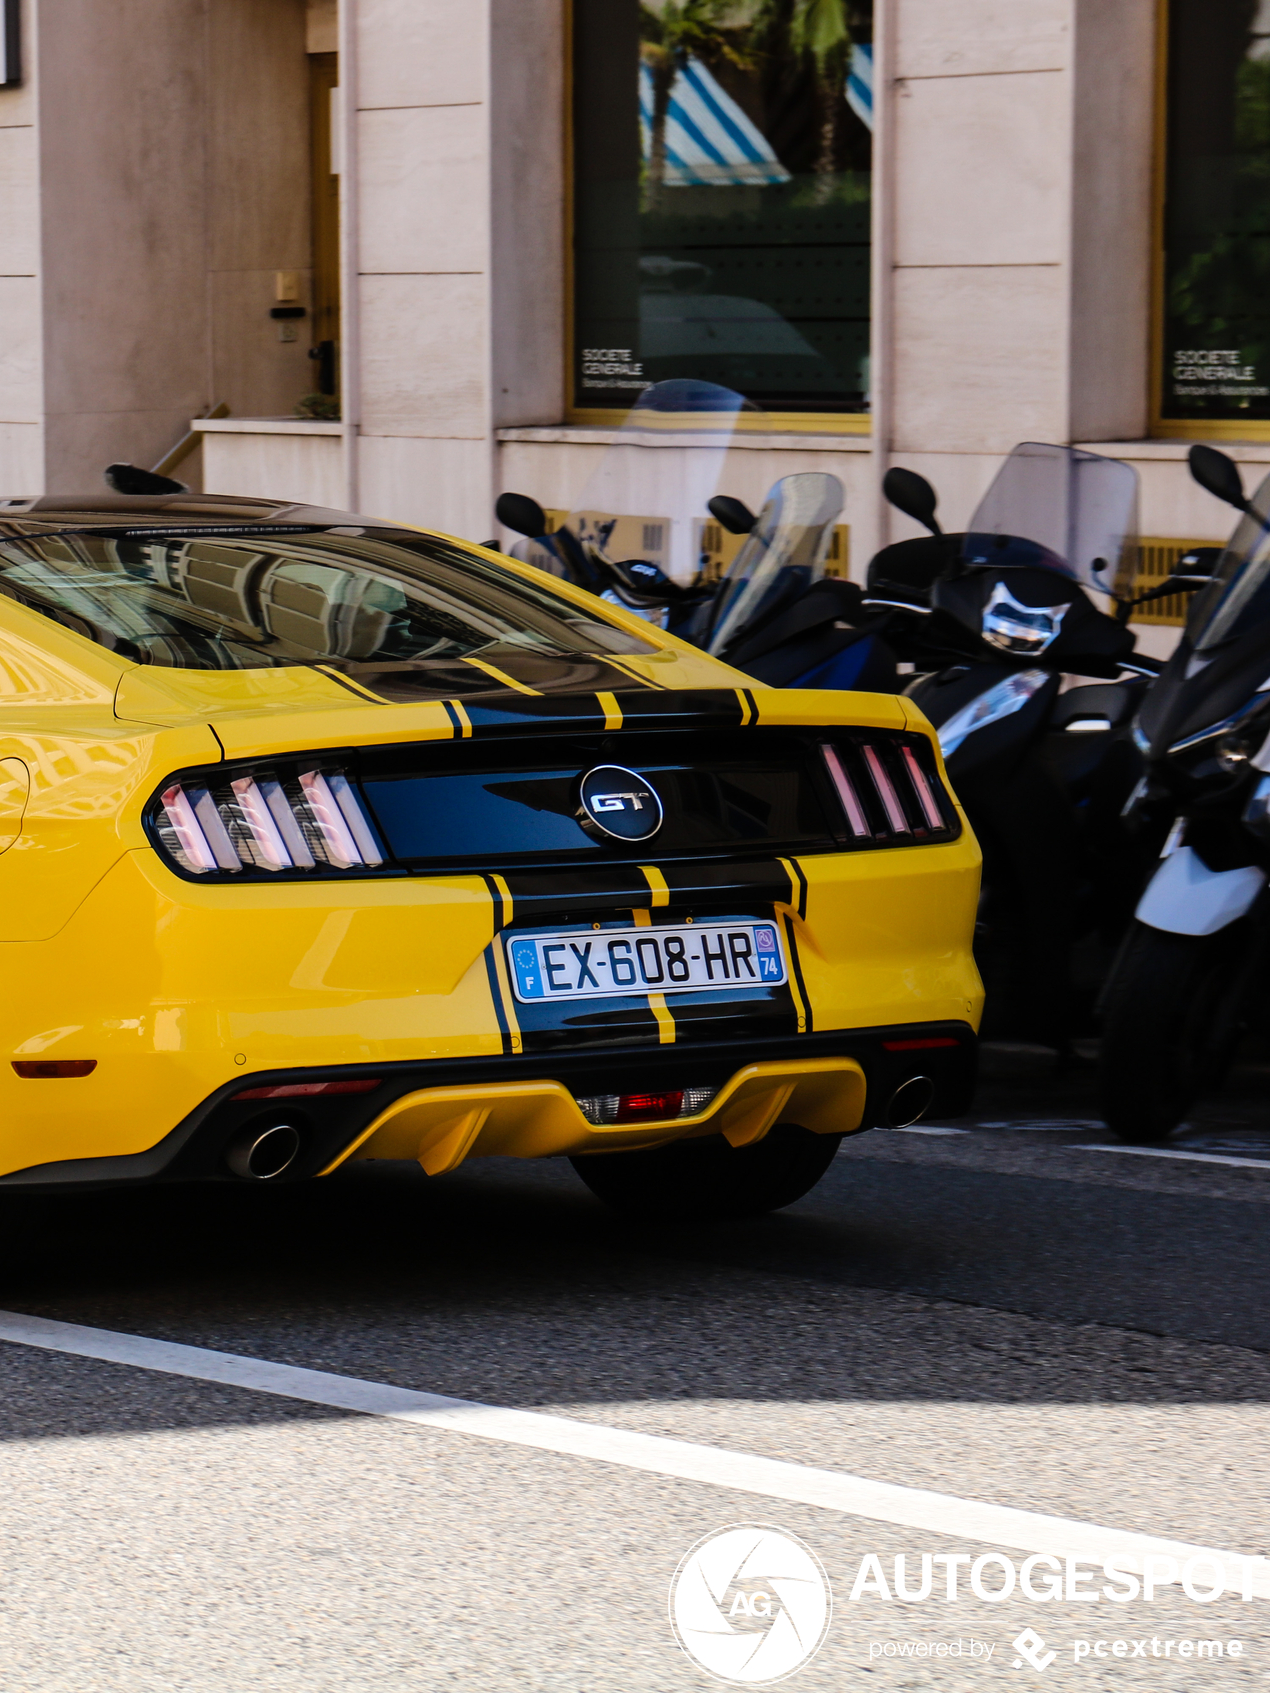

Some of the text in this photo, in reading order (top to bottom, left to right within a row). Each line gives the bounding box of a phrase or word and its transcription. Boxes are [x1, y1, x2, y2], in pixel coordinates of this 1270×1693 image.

[582, 348, 632, 361] SOCIETE
[1173, 350, 1241, 364] SOCIETE
[582, 362, 644, 375] GENERALE
[1172, 365, 1256, 380] GENERALE
[591, 792, 649, 813] GT
[525, 932, 778, 991] F EX-608-HR 74
